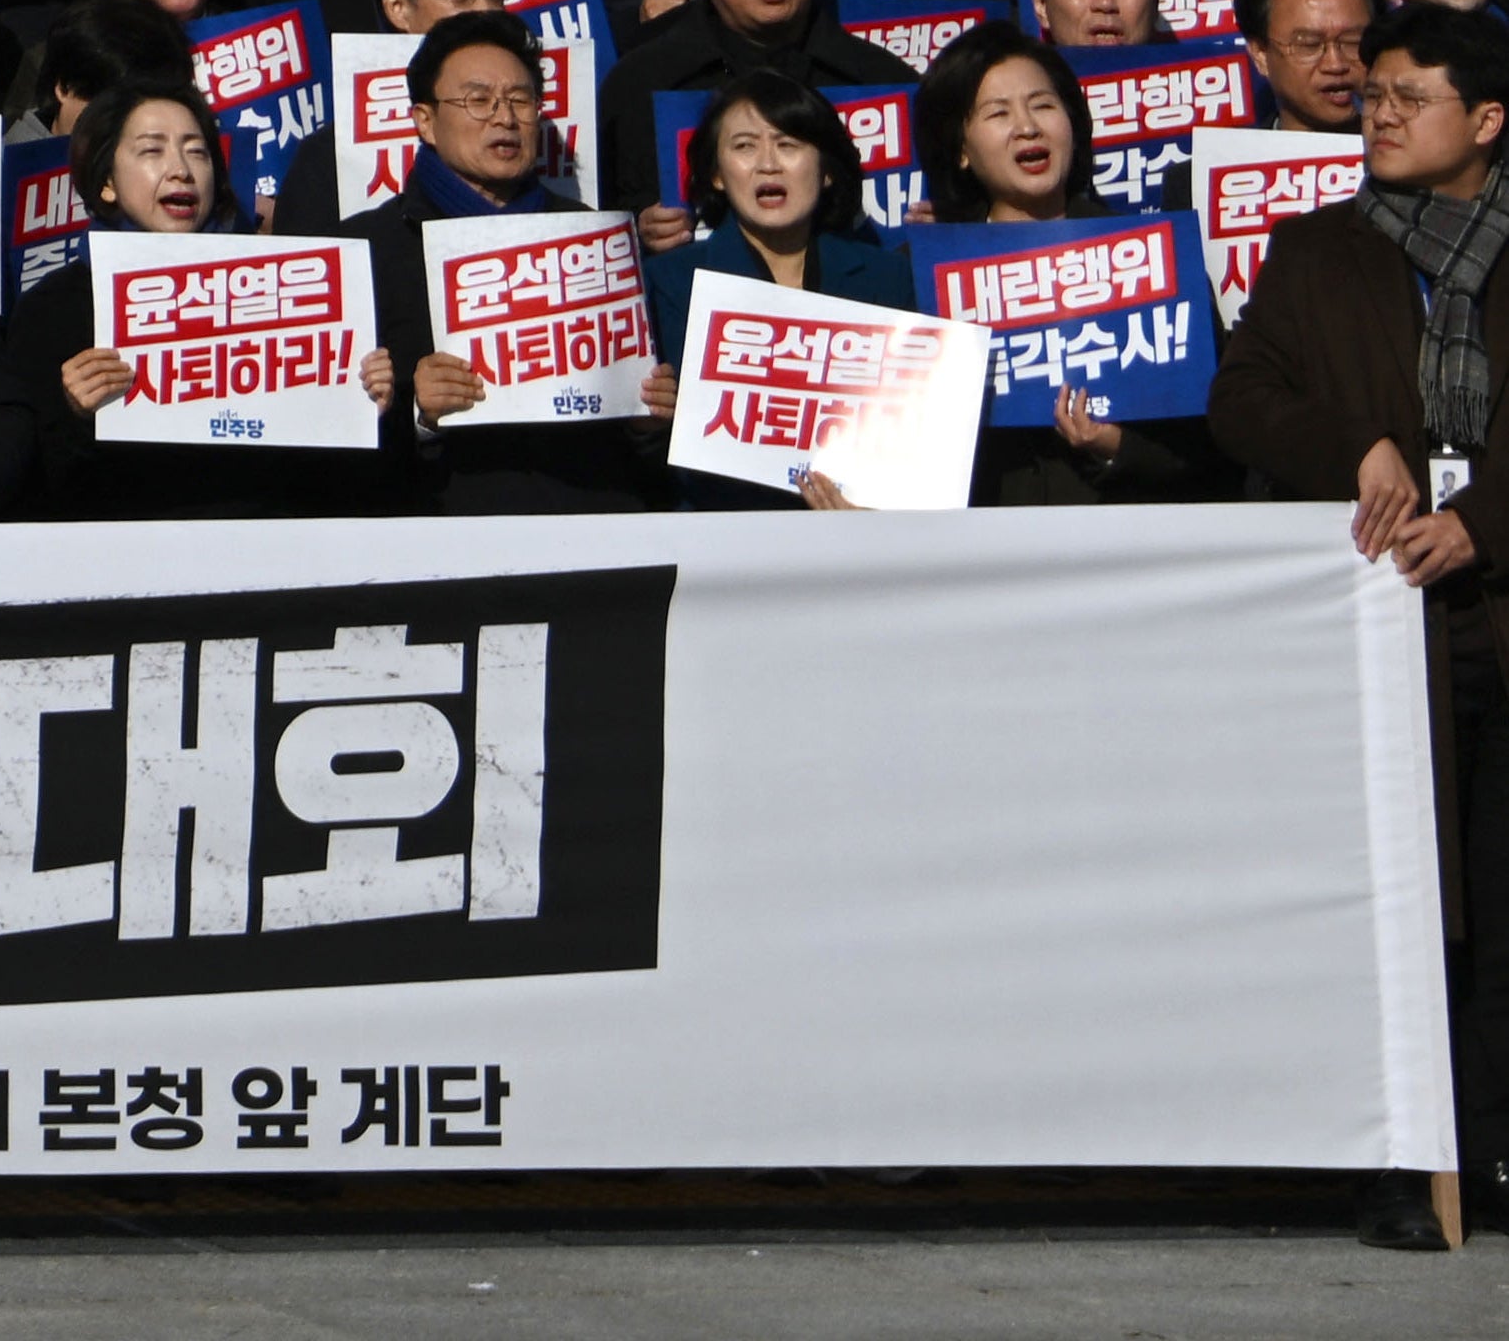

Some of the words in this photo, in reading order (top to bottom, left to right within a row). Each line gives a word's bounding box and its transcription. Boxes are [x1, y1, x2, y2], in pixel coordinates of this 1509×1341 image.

[125, 257, 329, 337] 윤석열은
[455, 233, 637, 322] 윤석열은
[943, 230, 1168, 322] 내란행위
[123, 329, 354, 406] 사퇴하라!
[476, 295, 650, 386] 사퇴하라
[38, 1066, 202, 1151] 본청
[231, 1067, 318, 1149] 앞
[338, 1063, 511, 1150] 계단
